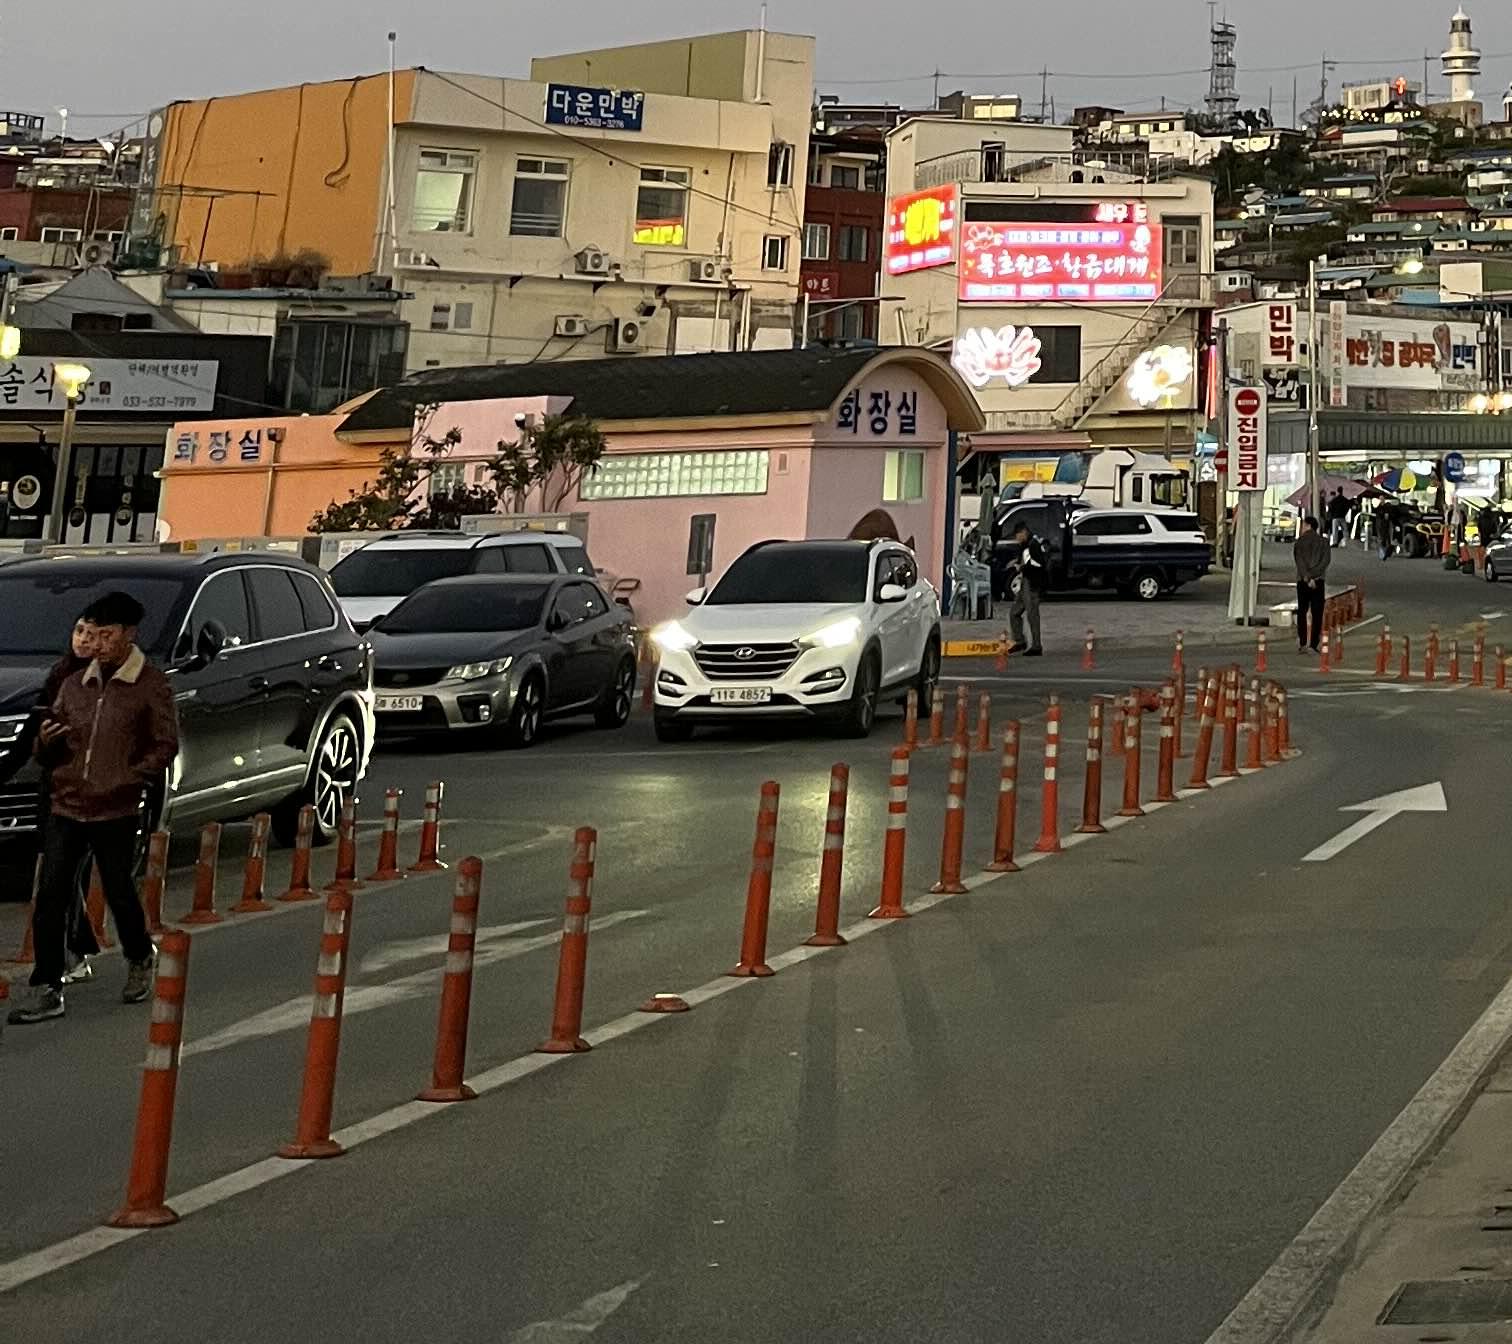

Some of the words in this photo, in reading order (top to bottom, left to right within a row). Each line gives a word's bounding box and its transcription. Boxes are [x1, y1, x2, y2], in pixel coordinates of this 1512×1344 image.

[552, 90, 640, 120] 다운민박
[1269, 305, 1295, 362] 민박
[838, 389, 917, 434] 화장실
[174, 429, 262, 463] 화장실
[1236, 417, 1258, 488] 진입금지
